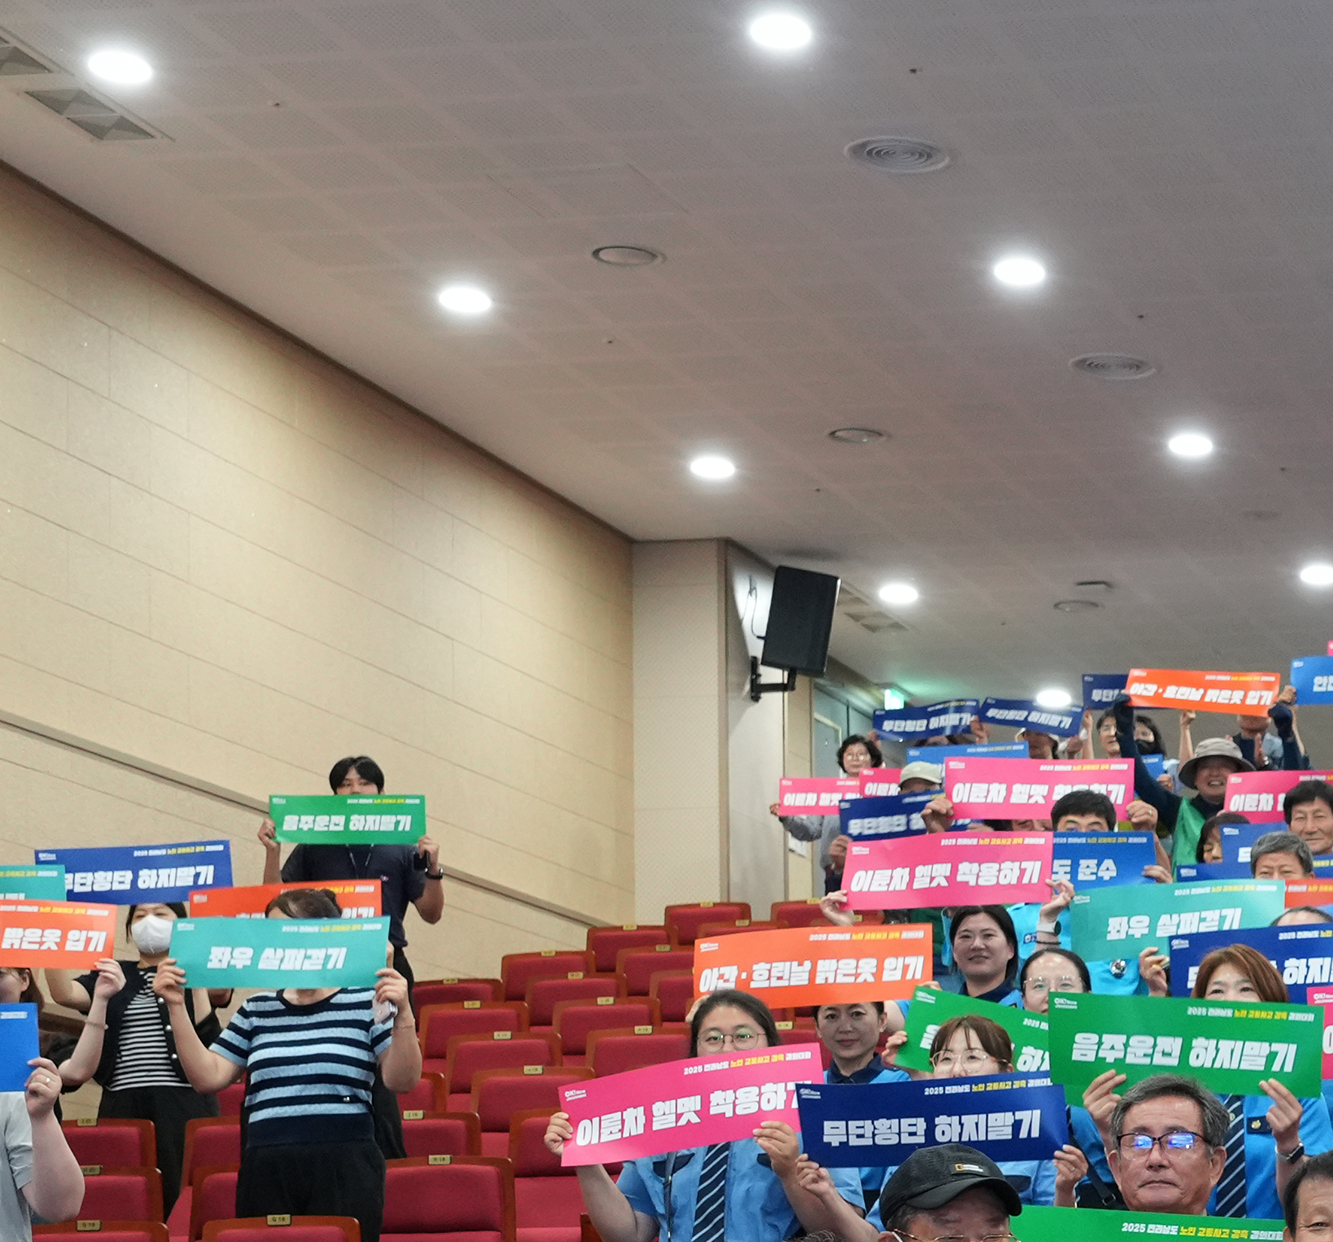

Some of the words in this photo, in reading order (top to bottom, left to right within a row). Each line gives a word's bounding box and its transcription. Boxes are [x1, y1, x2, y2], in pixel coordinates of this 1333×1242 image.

[952, 784, 1006, 803] 이륜차
[1010, 785, 1049, 803] 헬멧
[138, 864, 214, 890] 하지말기
[851, 869, 909, 892] 이륜차
[913, 864, 951, 888] 헬멧
[956, 861, 1041, 885] 착용하기
[1078, 859, 1117, 880] 준수
[1107, 915, 1150, 940] 좌우
[1156, 908, 1241, 936] 살펴걷기
[64, 929, 107, 953] 입기
[207, 947, 252, 969] 좌우
[258, 946, 347, 971] 살펴걷기
[700, 966, 738, 992] 야간
[751, 960, 810, 987] 흐린날
[815, 958, 877, 983] 밝은옷
[882, 956, 924, 981] 입기
[1071, 1033, 1182, 1067] 음주운전
[1189, 1038, 1297, 1073] 하지말기
[576, 1108, 645, 1146] 이륜차
[651, 1096, 701, 1132] 헬멧
[822, 1120, 926, 1147] 무단횡단
[935, 1110, 1041, 1142] 하지말기
[1122, 1223, 1148, 1232] 2025
[1147, 1224, 1178, 1234] 전라남도
[1180, 1227, 1198, 1236] 노인
[1198, 1228, 1230, 1238] 교통사고
[1229, 1230, 1248, 1238] 감축
